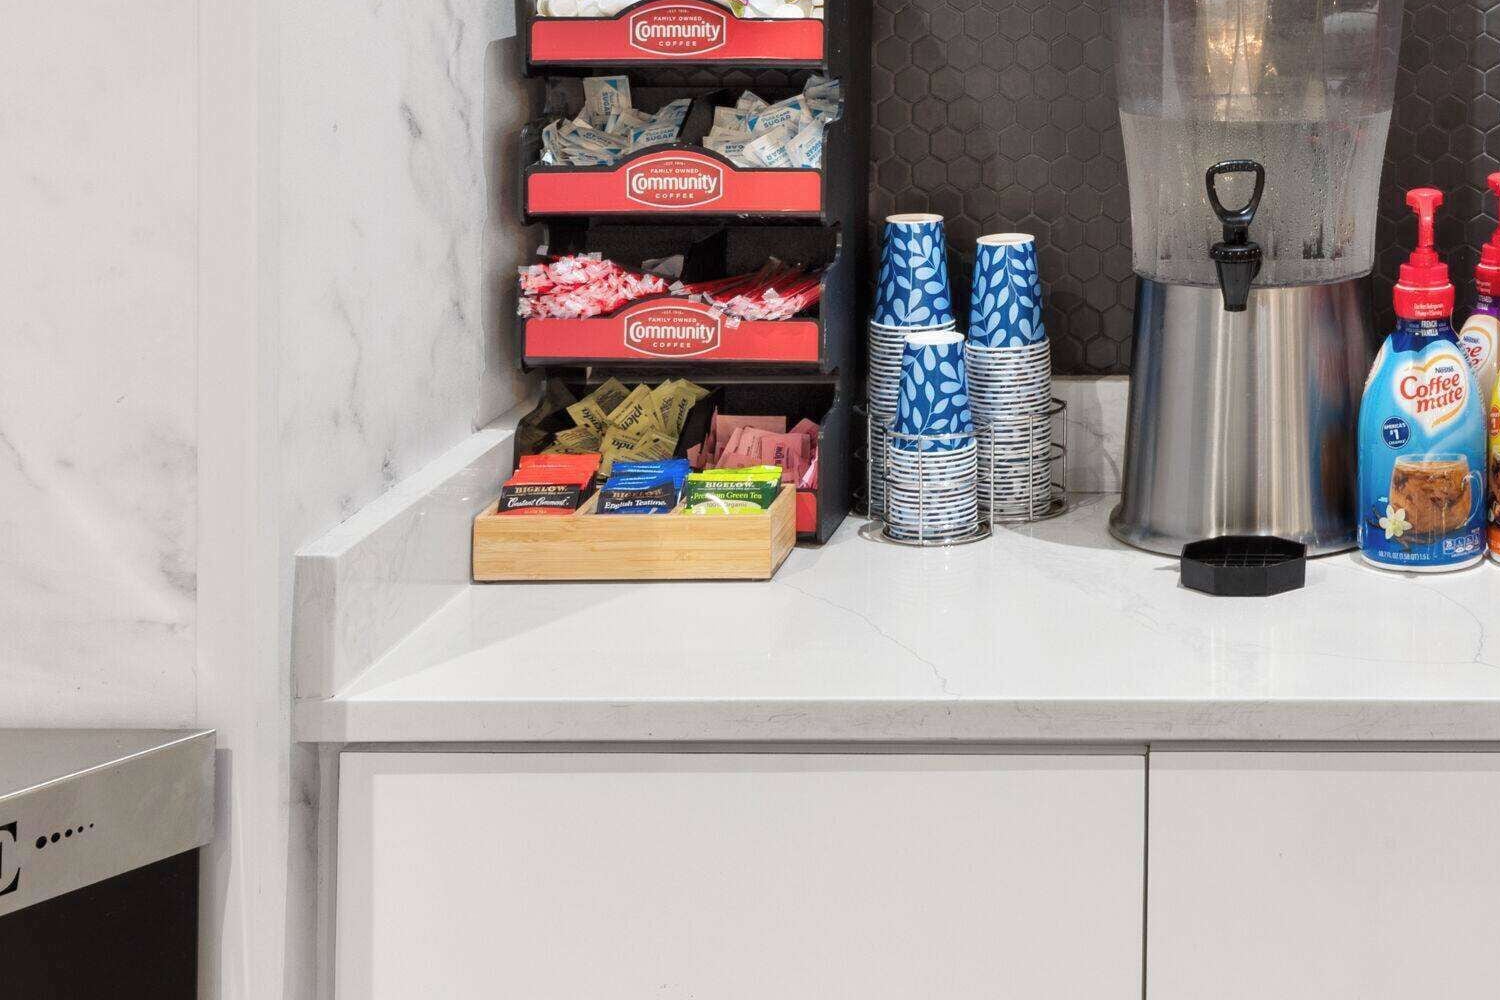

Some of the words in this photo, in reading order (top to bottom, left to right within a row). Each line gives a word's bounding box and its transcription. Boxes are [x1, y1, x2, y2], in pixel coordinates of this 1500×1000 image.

[635, 21, 720, 42] Community
[764, 114, 791, 128] SUGAR
[646, 133, 674, 142] SUGAR
[632, 173, 717, 194] Community
[629, 322, 715, 343] Community
[1400, 373, 1460, 399] Coffee
[1416, 386, 1462, 413] mate
[604, 501, 633, 509] English
